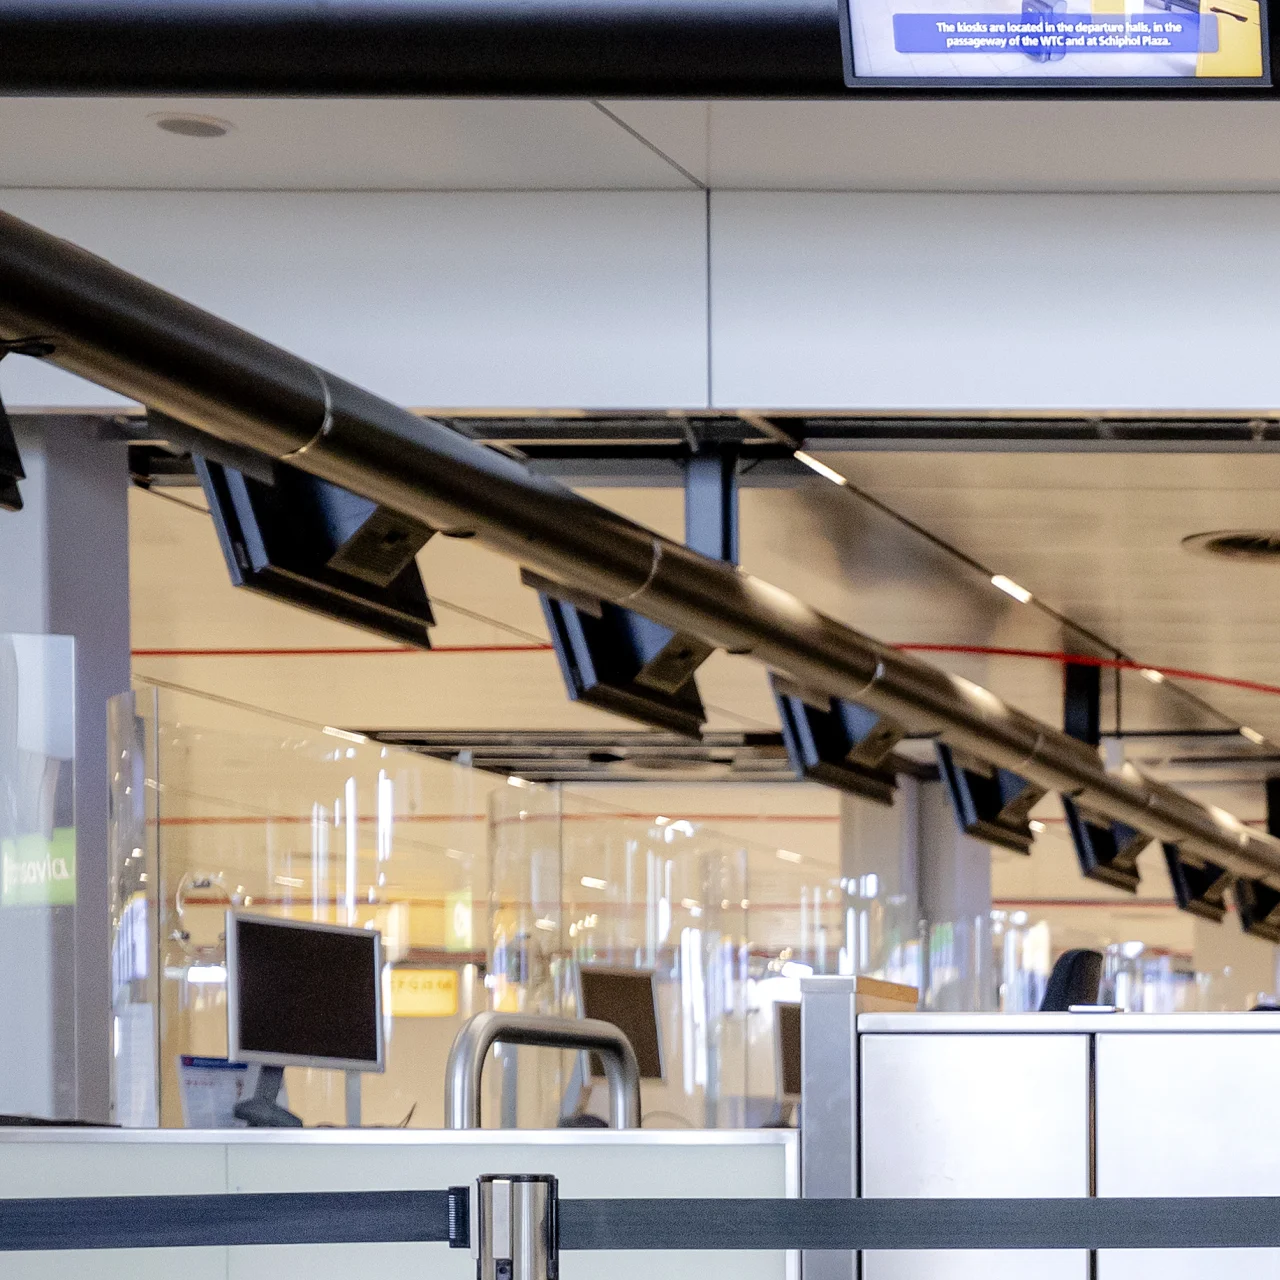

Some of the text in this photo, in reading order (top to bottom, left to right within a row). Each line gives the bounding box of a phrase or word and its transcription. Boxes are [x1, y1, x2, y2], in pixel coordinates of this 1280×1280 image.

[936, 21, 1182, 34] The kiosks are located in the departure halls, in the
[946, 35, 1171, 48] passageway of the WTC and at Schiphol Plaza.
